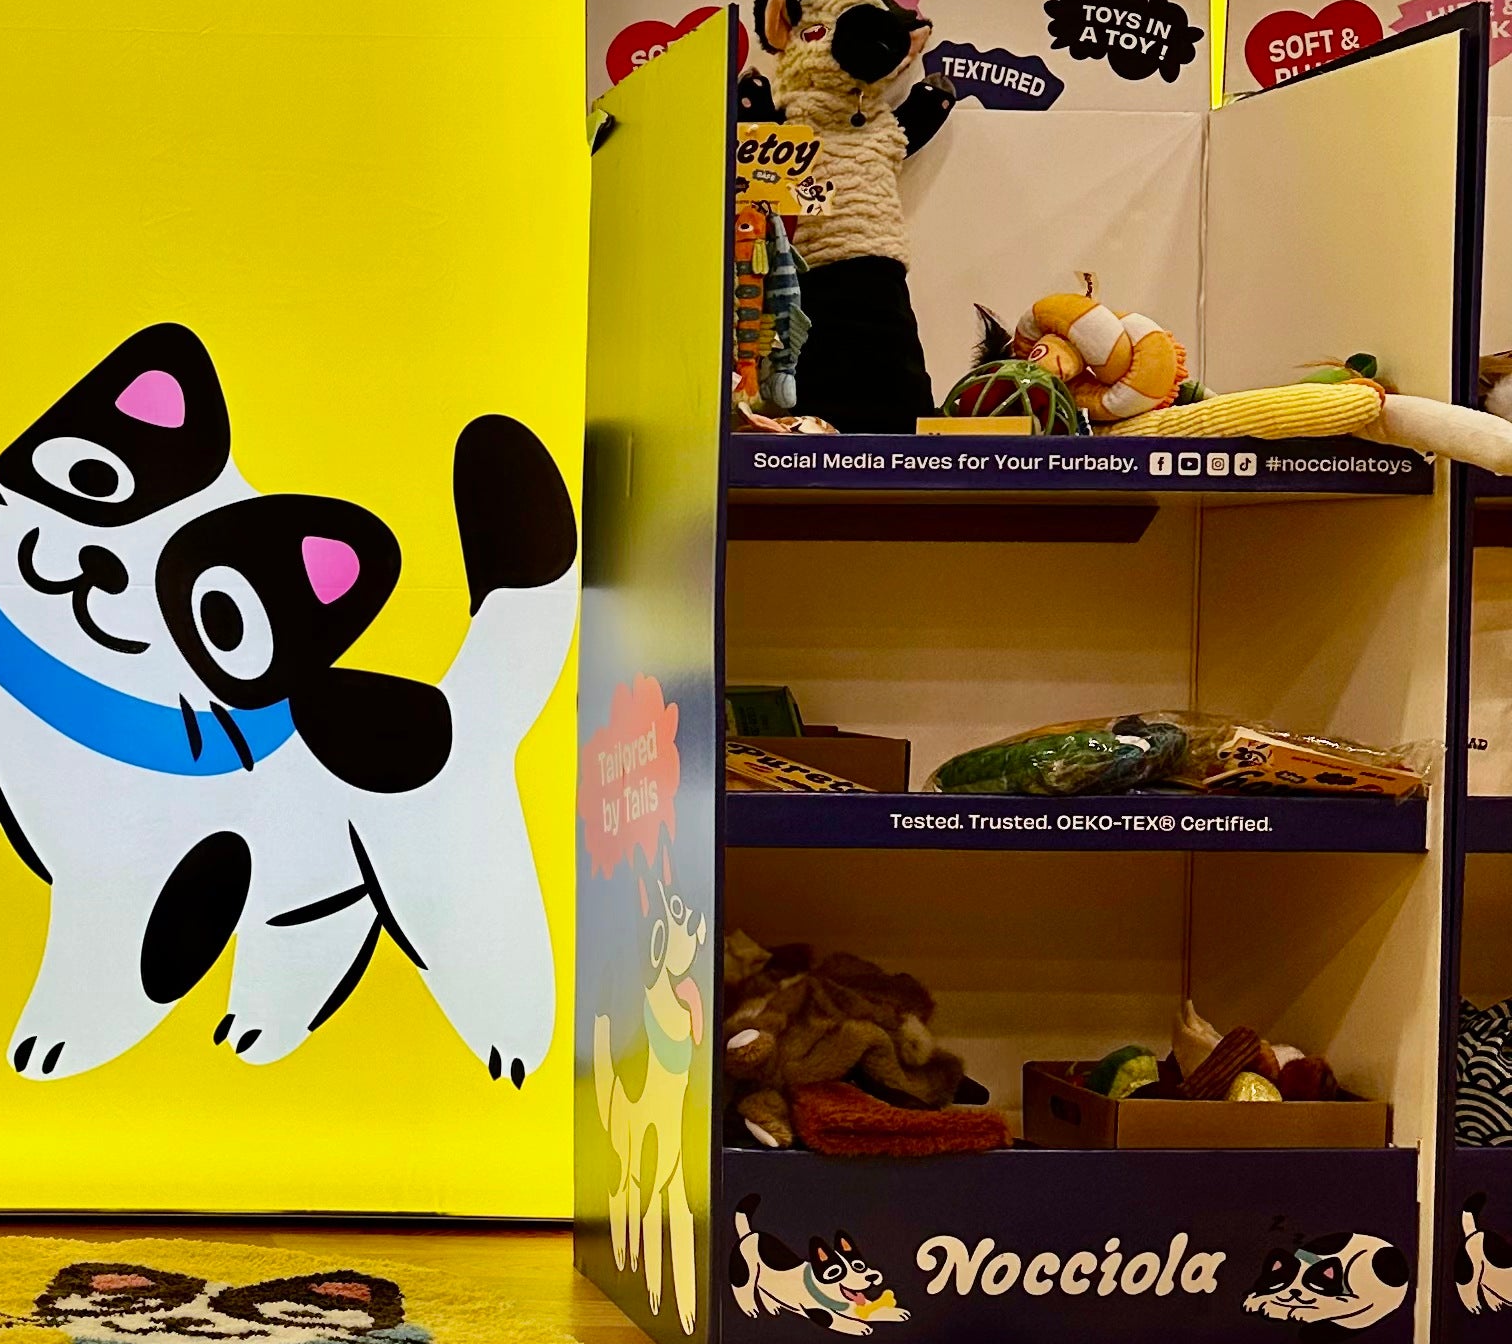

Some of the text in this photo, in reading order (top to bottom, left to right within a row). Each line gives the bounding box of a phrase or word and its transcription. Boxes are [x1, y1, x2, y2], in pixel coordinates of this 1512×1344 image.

[1079, 26, 1098, 44] A
[1082, 4, 1172, 40] TOYS IN
[1268, 27, 1361, 64] SOFT &
[941, 56, 1046, 98] TEXTURED
[736, 133, 821, 176] etoy
[753, 452, 1413, 475] Social Media Faves for Your Furbaby. #nocciolatoys
[598, 721, 658, 787] Tailored
[602, 776, 659, 836] by Tails
[889, 813, 1273, 832] Tested. Trusted. OEKO-TEX® Certified.
[916, 1232, 1227, 1297] Nocciola
